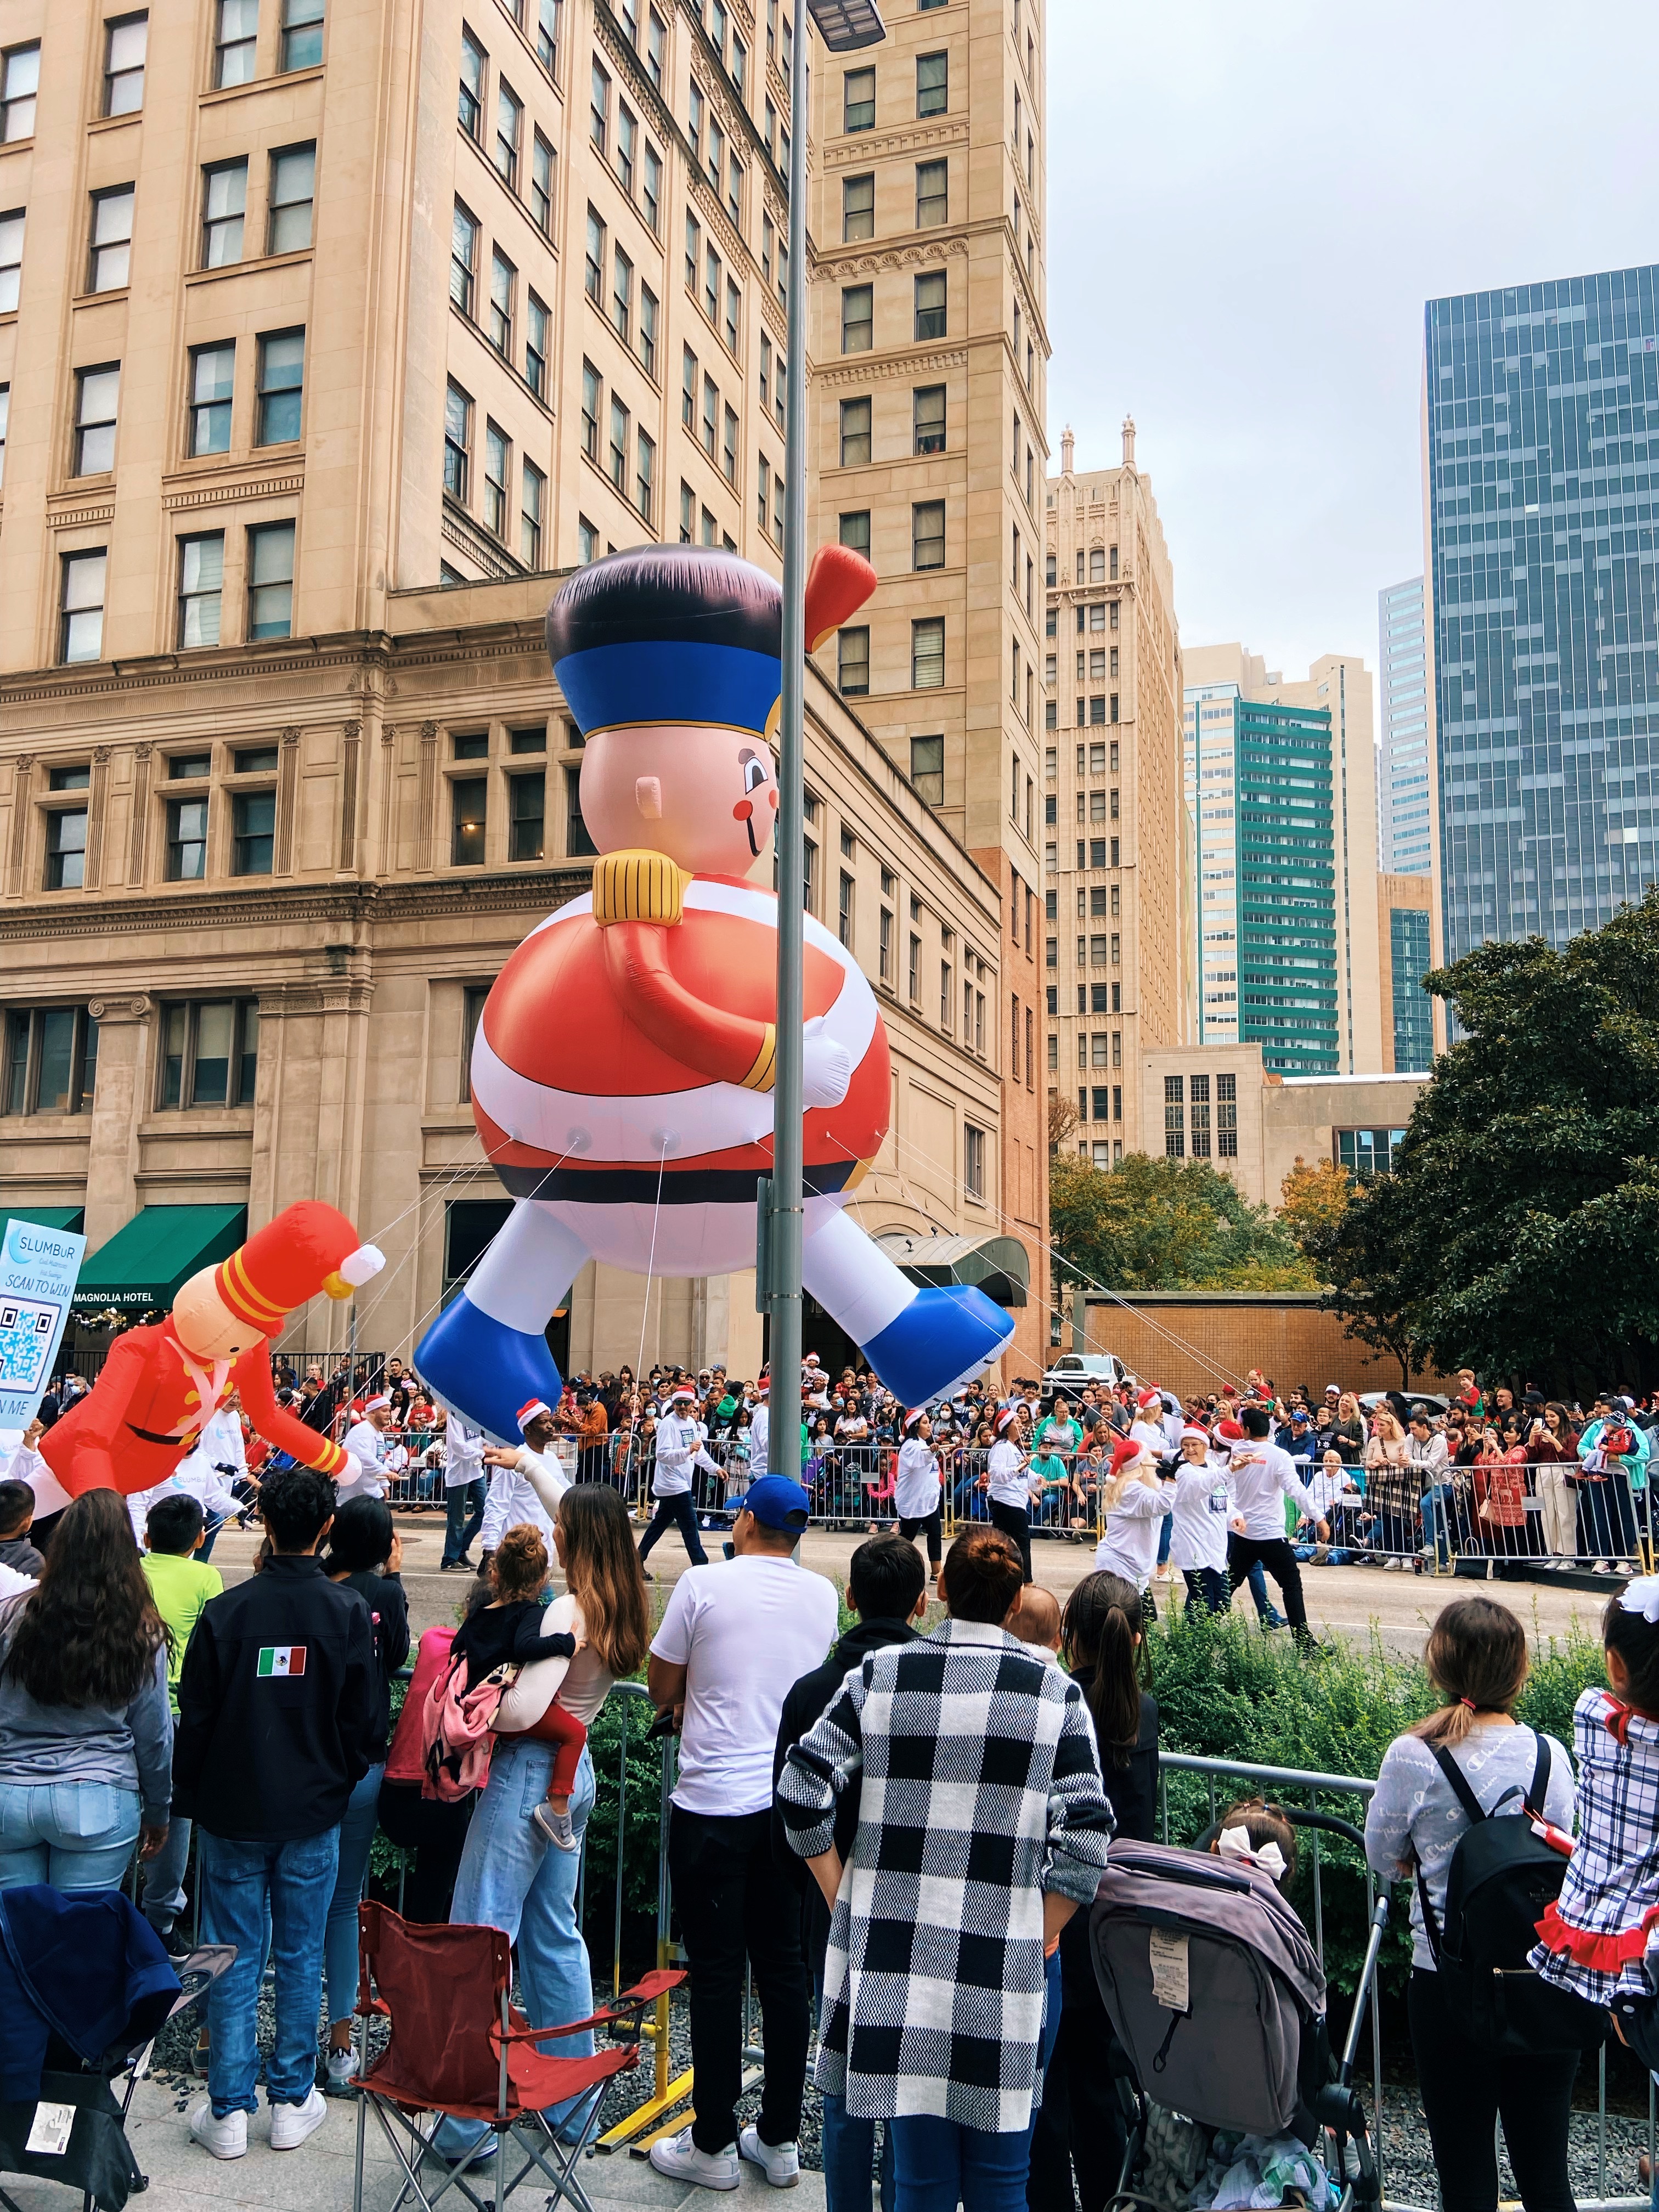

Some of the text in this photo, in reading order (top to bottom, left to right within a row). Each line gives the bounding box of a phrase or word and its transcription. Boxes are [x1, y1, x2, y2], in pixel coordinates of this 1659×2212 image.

[5, 1274, 35, 1291] SCAN
[35, 1279, 49, 1294] TO
[49, 1282, 71, 1297] WIN
[74, 1293, 154, 1302] MAGNOLIA HOTEL
[8, 1400, 29, 1415] ME
